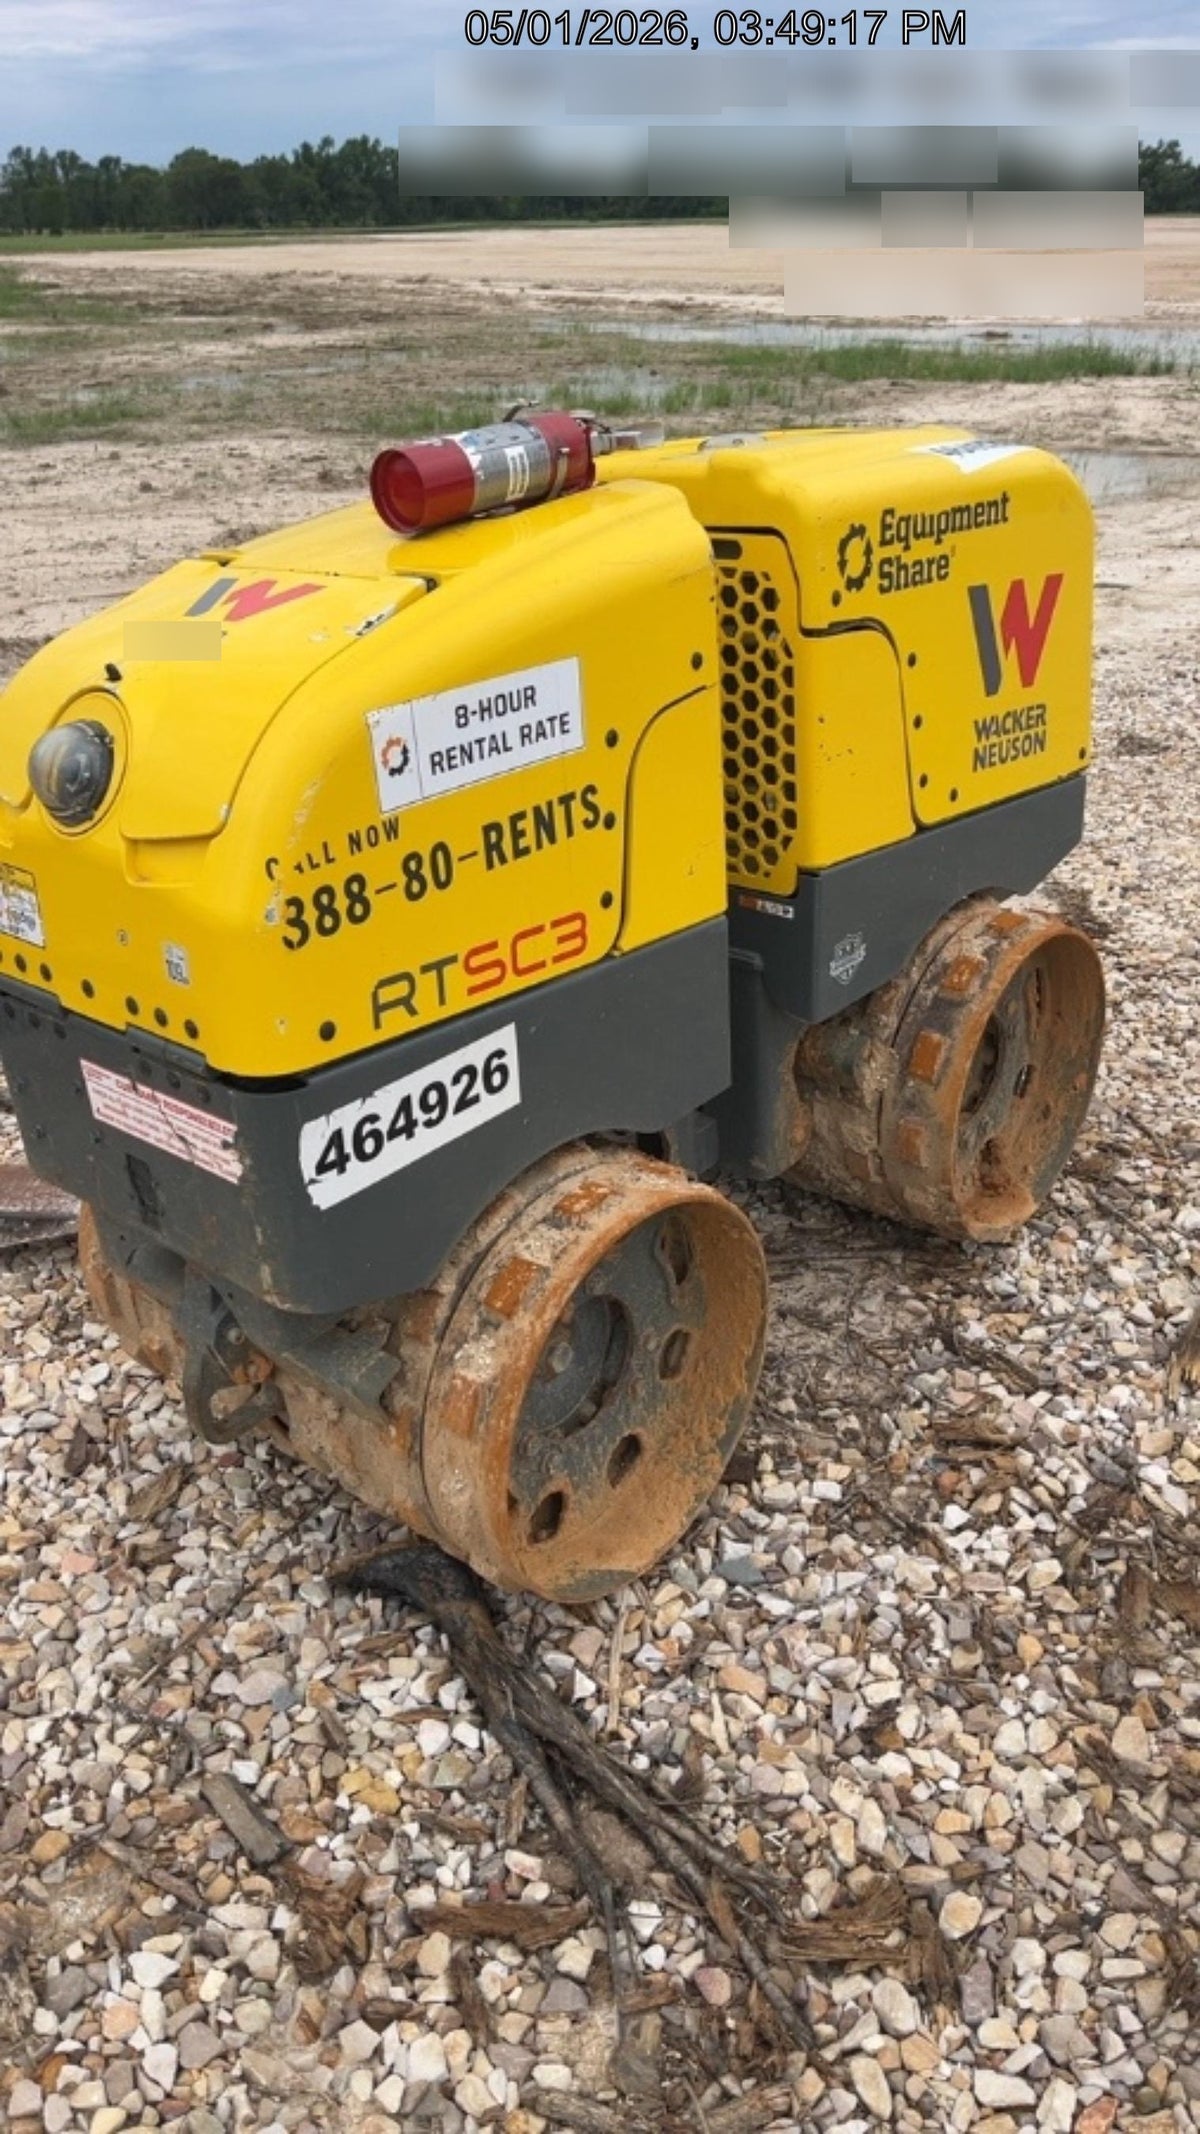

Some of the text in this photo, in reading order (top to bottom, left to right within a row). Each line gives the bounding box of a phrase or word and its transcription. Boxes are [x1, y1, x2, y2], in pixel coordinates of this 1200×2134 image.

[878, 491, 1010, 551] Equipment
[878, 554, 950, 595] Share
[455, 684, 537, 729] 8-HOUR
[974, 703, 1047, 743] WACKER
[429, 712, 571, 776] RENTAL RATE
[972, 729, 1047, 773] NEUSON
[347, 817, 400, 856] NOW
[371, 911, 588, 1030] RTSC3
[315, 1048, 510, 1177] 464926
